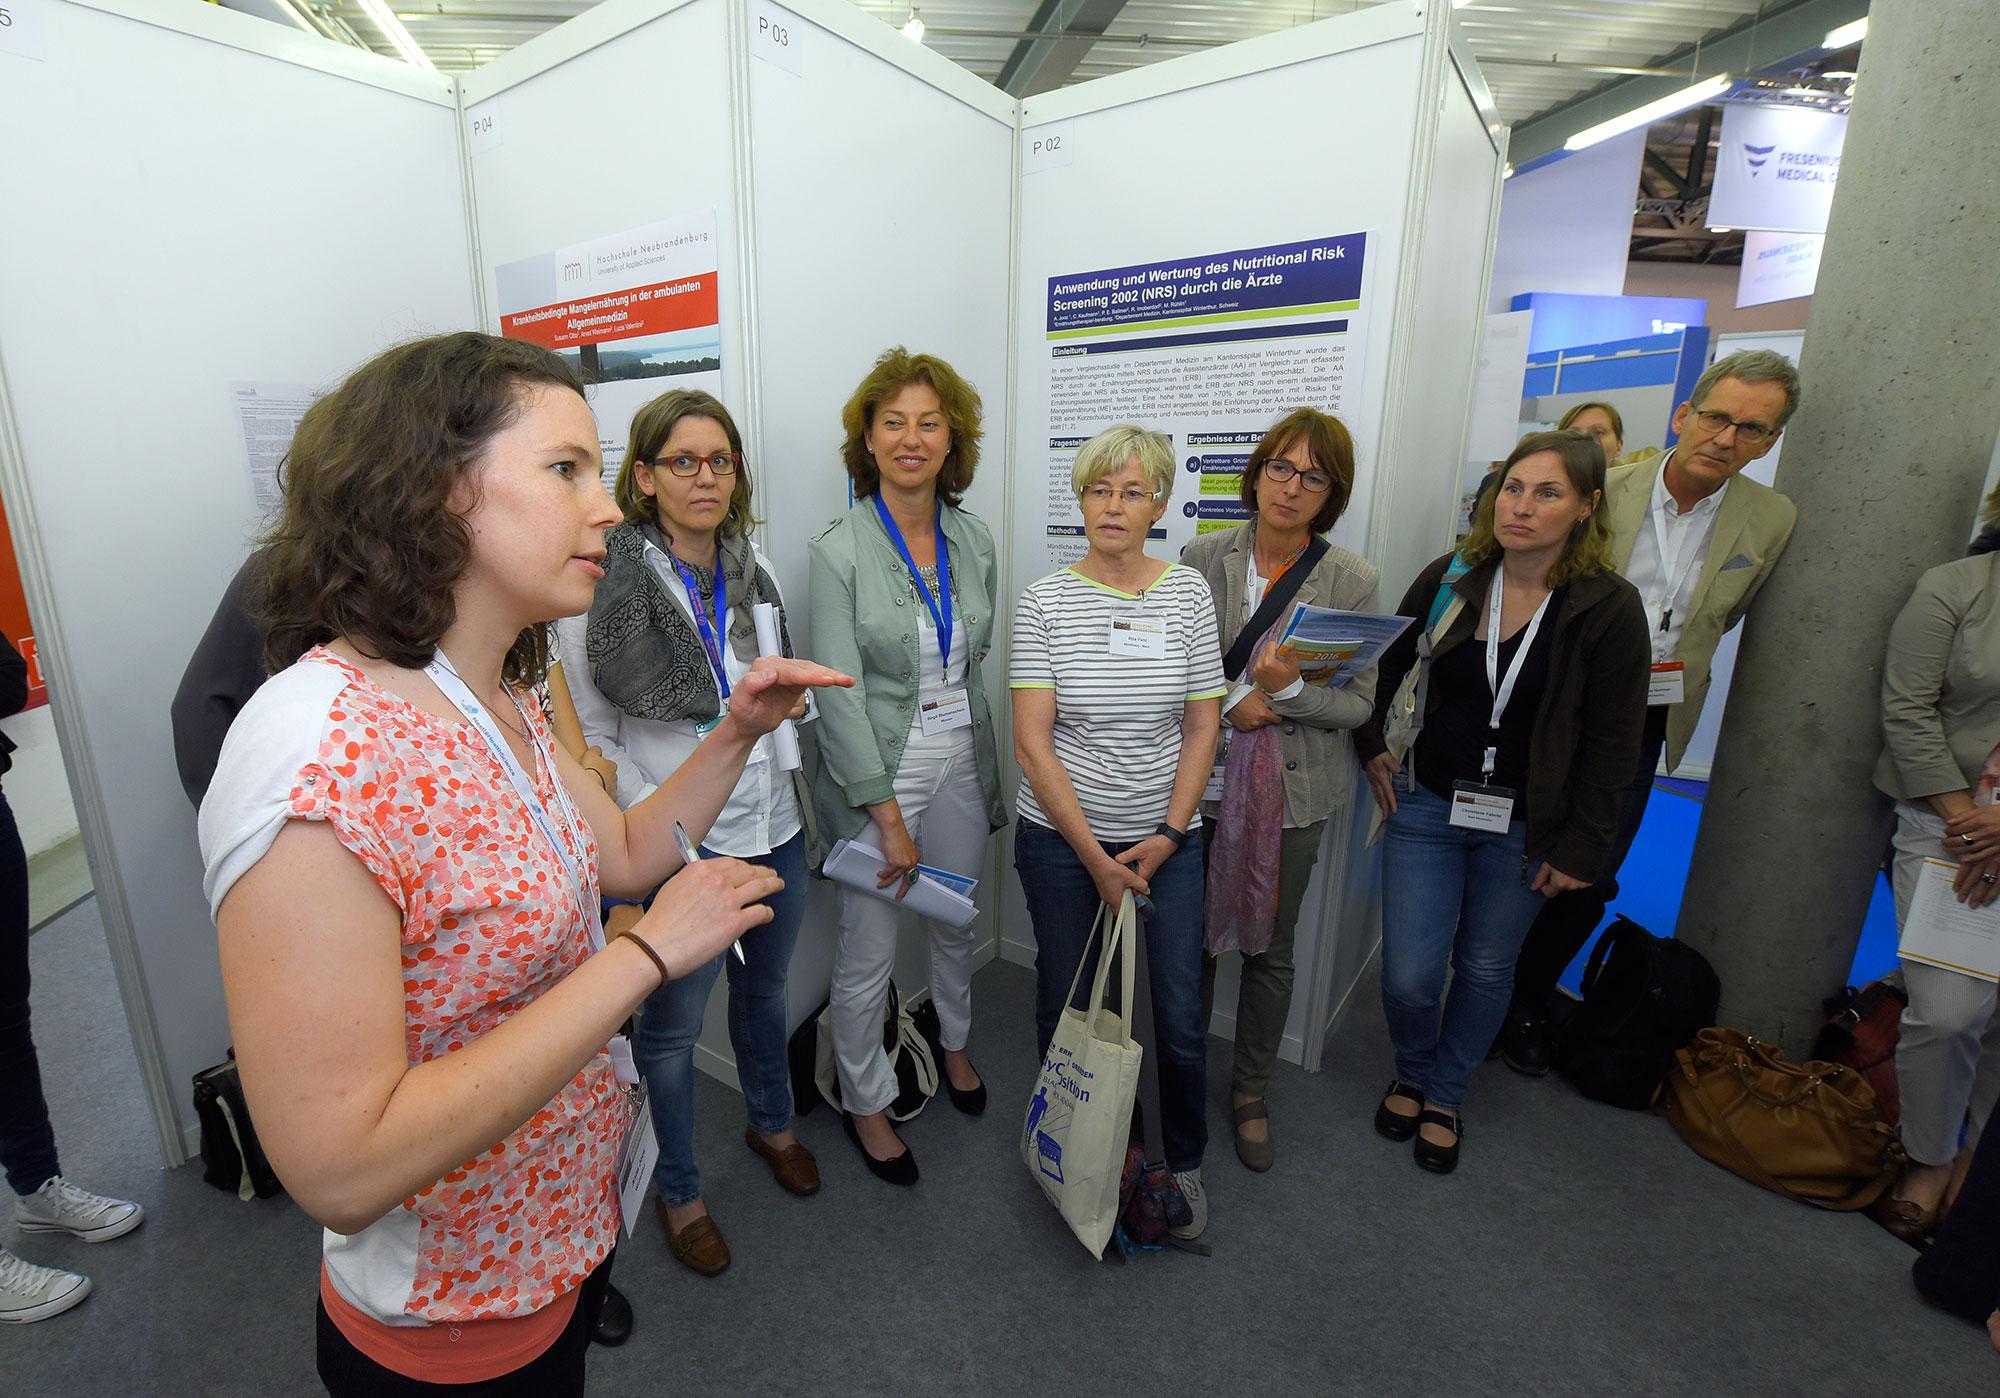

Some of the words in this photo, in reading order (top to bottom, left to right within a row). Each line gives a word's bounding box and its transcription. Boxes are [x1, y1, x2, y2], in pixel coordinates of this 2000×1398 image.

[759, 16, 769, 34] P
[772, 24, 789, 47] 03
[473, 121, 480, 136] P
[481, 115, 493, 133] 04
[1033, 140, 1042, 155] P
[1045, 135, 1061, 152] 02
[1776, 168, 1826, 183] MEDICAL
[1829, 172, 1839, 183] C
[596, 247, 638, 265] Hochschule
[640, 232, 708, 254] Neubrandenburg
[597, 265, 619, 276] University
[625, 259, 643, 270] Applied
[643, 254, 666, 267] Sciences
[1053, 277, 1120, 296] Anwendung
[1122, 271, 1146, 287] und
[1148, 266, 1202, 283] Wertung
[1204, 262, 1229, 276] des
[1232, 249, 1308, 272] Nutritional
[1311, 244, 1346, 262] Risk
[1053, 295, 1109, 312] Screening
[1110, 290, 1139, 305] 2002
[1141, 284, 1177, 303] (NRS)
[1180, 280, 1218, 296] durch
[1221, 277, 1242, 291] die
[1245, 271, 1283, 289] Ärzte
[512, 306, 568, 327] Krankheitsbedingte
[568, 294, 630, 316] Mangelernährung
[630, 292, 638, 303] in
[638, 290, 653, 301] der
[653, 281, 701, 299] ambulanten
[567, 309, 628, 331] Allgemeinmedizin
[1053, 347, 1088, 356] Einleitung
[1076, 363, 1121, 374] Vergleichsstudie
[1134, 358, 1173, 368] Departement
[1175, 356, 1200, 364] Medizin
[1217, 351, 1262, 361] Kantonsspital
[1265, 349, 1302, 357] Winterthur
[1305, 346, 1328, 354] wurde
[1136, 368, 1151, 376] NRS
[1152, 367, 1170, 375] durch
[1183, 363, 1229, 373] Assistenzärzte
[1230, 361, 1247, 370] (AA)
[1259, 359, 1291, 369] Vergleich
[1311, 354, 1345, 364] erfassten
[1101, 375, 1177, 387] Ernährungstherapeutinnen
[1182, 373, 1202, 382] (ERB)
[1206, 369, 1256, 380] unterschiedlich
[1313, 365, 1326, 373] Die
[1332, 364, 1344, 372] AA
[1050, 390, 1080, 398] verwenden
[1094, 388, 1108, 396] NRS
[1164, 383, 1191, 391] während
[1222, 380, 1236, 388] den
[1238, 379, 1255, 387] NRS
[1257, 378, 1274, 386] nach
[1277, 377, 1299, 385] einem
[1301, 374, 1343, 383] detaillierten
[1159, 393, 1175, 401] hohe
[1252, 387, 1285, 396] Patienten
[1304, 385, 1327, 393] Risiko
[1077, 412, 1114, 422] Kurzschulung
[1126, 411, 1158, 420] Bedeutung
[1159, 410, 1171, 418] und
[1172, 408, 1209, 418] Anwendung
[1224, 407, 1241, 415] NRS
[1242, 406, 1262, 414] sowie
[1327, 402, 1340, 411] ME
[1097, 404, 1112, 412] (ME)
[1157, 401, 1172, 409] nicht
[1224, 397, 1259, 407] Einführung
[1286, 395, 1306, 403] findet
[1307, 394, 1328, 402] durch
[1329, 393, 1341, 401] die
[1188, 434, 1233, 446] Ergebnisse
[1235, 434, 1249, 442] der
[1189, 460, 1197, 469] a)
[1047, 510, 1071, 519] genügen.
[1048, 503, 1072, 511] Anleitung
[1186, 506, 1194, 514] b)
[1047, 526, 1078, 535] Methodik
[1313, 652, 1341, 660] 2016
